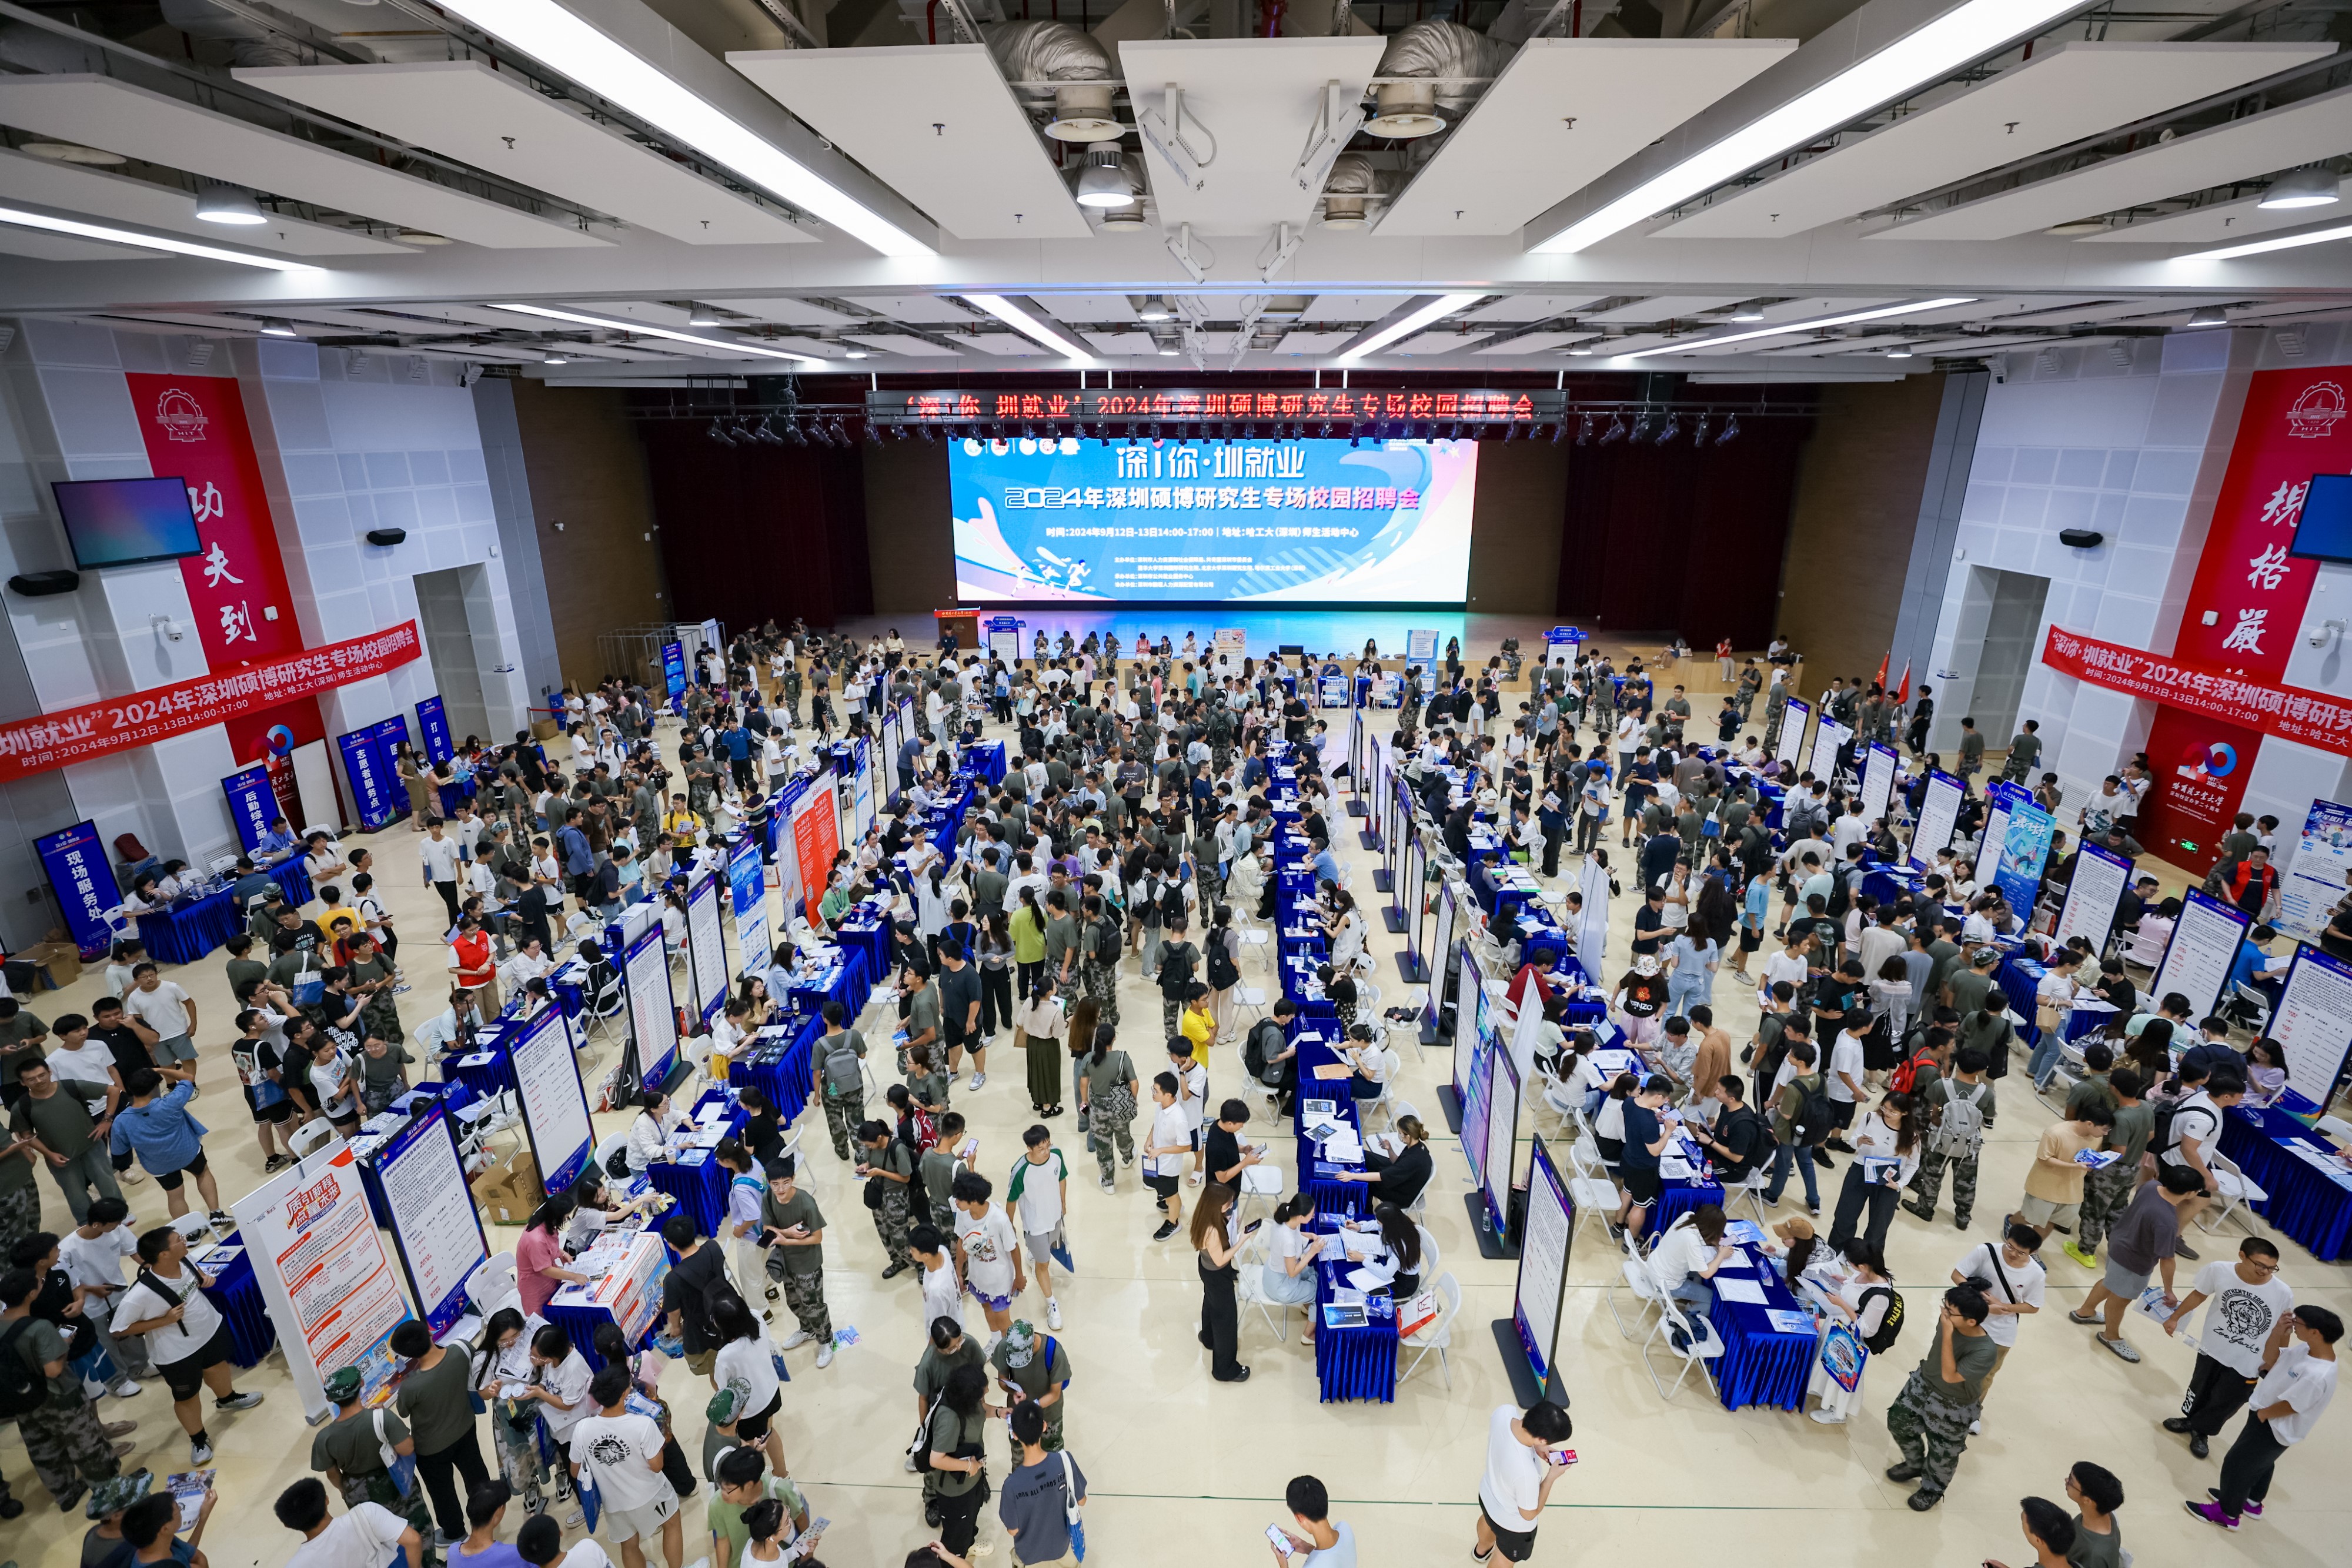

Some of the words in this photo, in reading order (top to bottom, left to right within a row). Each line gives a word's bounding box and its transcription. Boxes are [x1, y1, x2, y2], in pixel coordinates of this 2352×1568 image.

[1004, 486, 1420, 510] 2024年深圳硕博研究生专场校园招聘会
[355, 748, 380, 808] 志愿者服务点
[65, 850, 103, 922] 现场服务处
[1630, 999, 1653, 1011] KENZO
[2253, 1295, 2264, 1305] ZOO
[2263, 1304, 2272, 1318] YORK
